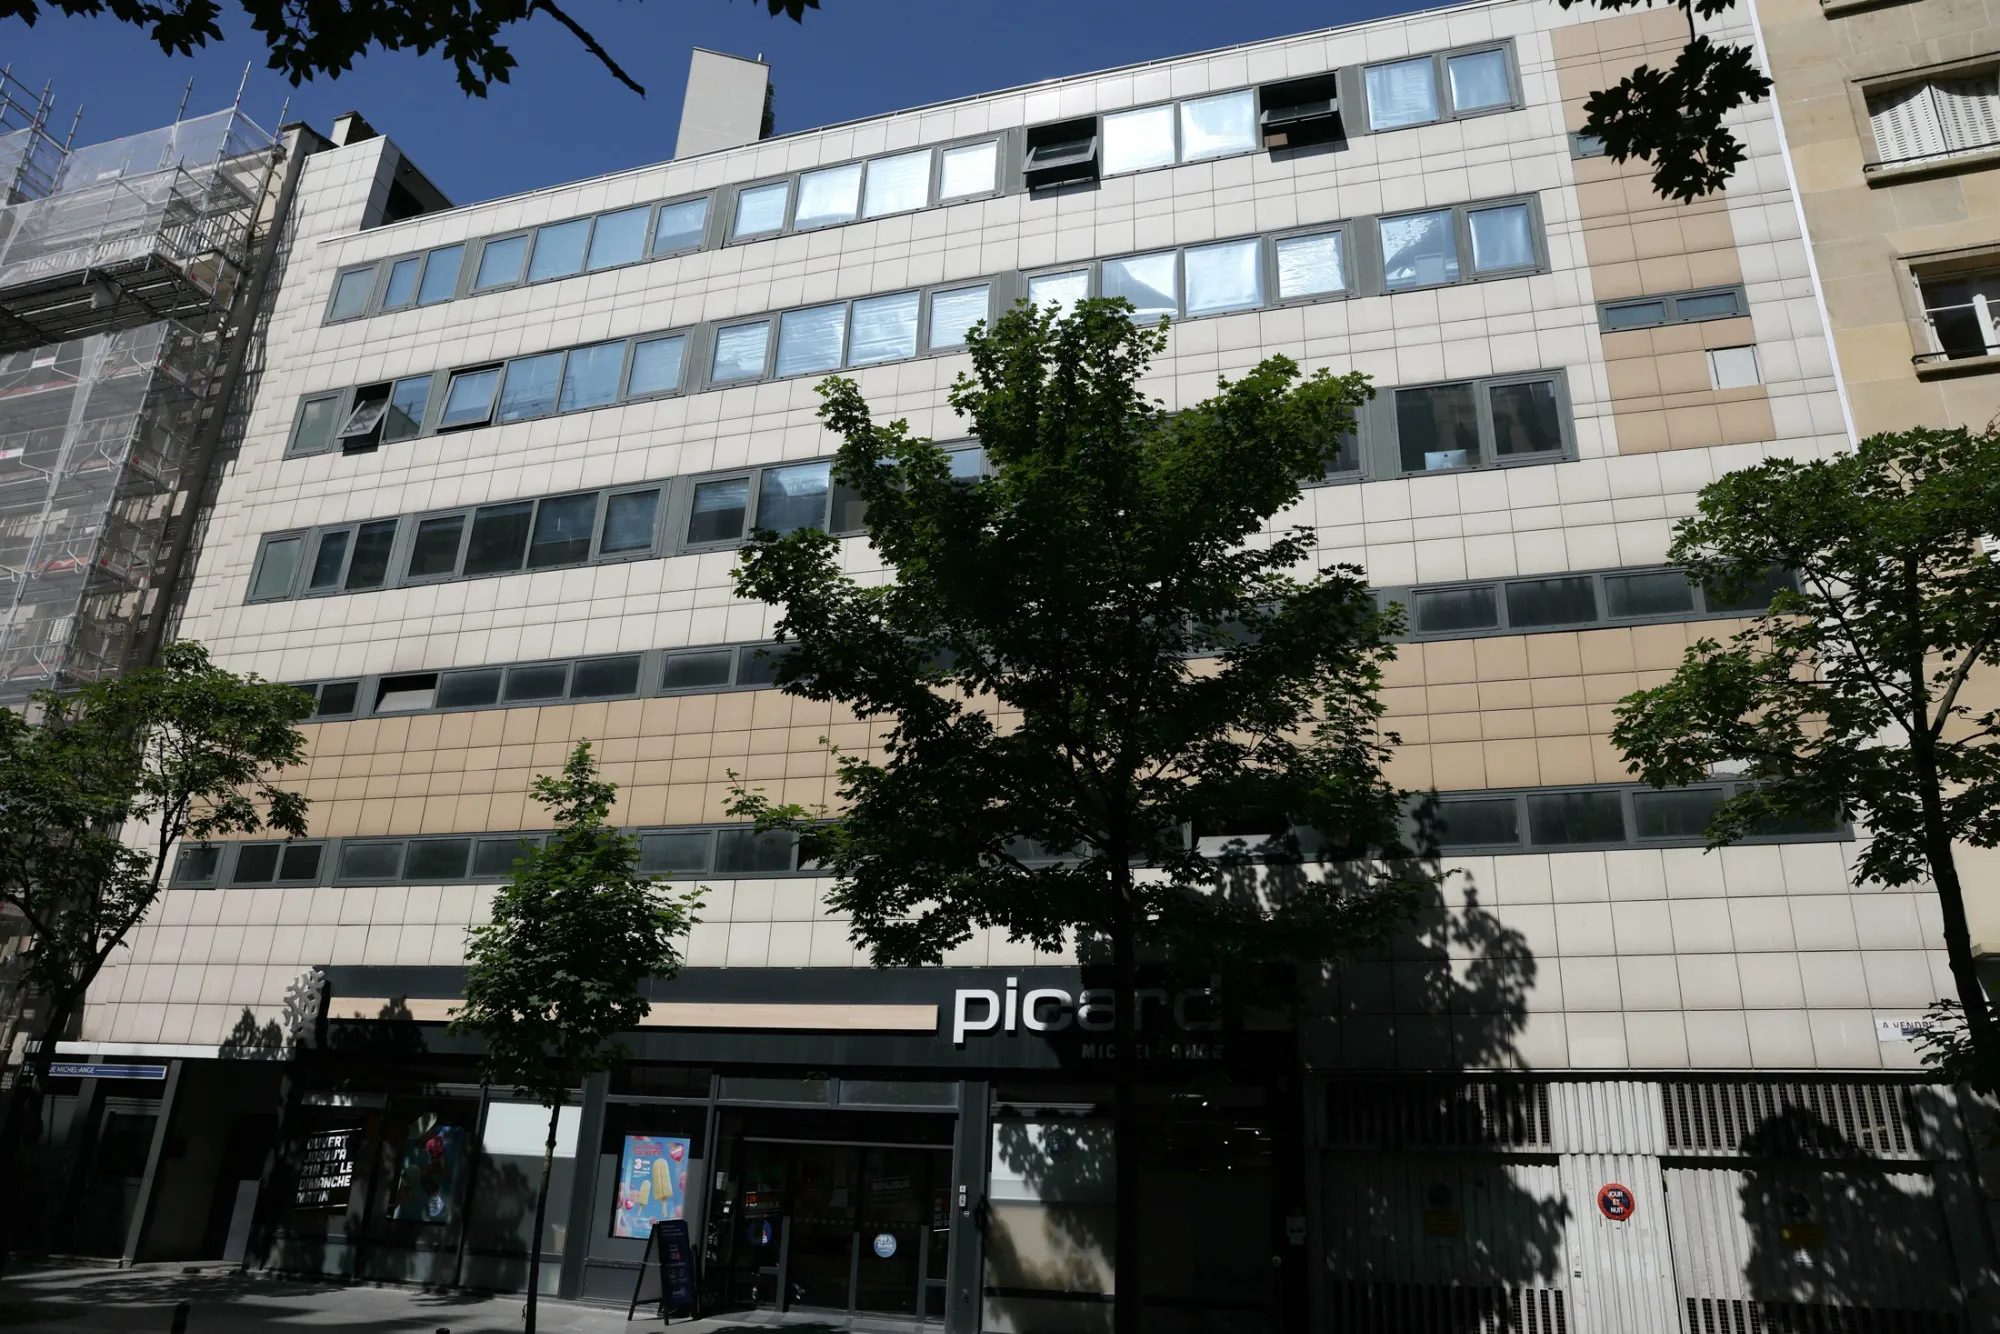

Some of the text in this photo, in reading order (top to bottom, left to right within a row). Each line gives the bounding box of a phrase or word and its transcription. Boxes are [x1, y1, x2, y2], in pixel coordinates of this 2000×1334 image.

[953, 975, 1224, 1044] picard
[57, 1066, 95, 1074] MICHEL-ANGE
[307, 1135, 349, 1150] OUVERT
[301, 1161, 354, 1177] 21H ET LE
[298, 1174, 352, 1190] DIMANCHE
[296, 1189, 330, 1204] MATIN
